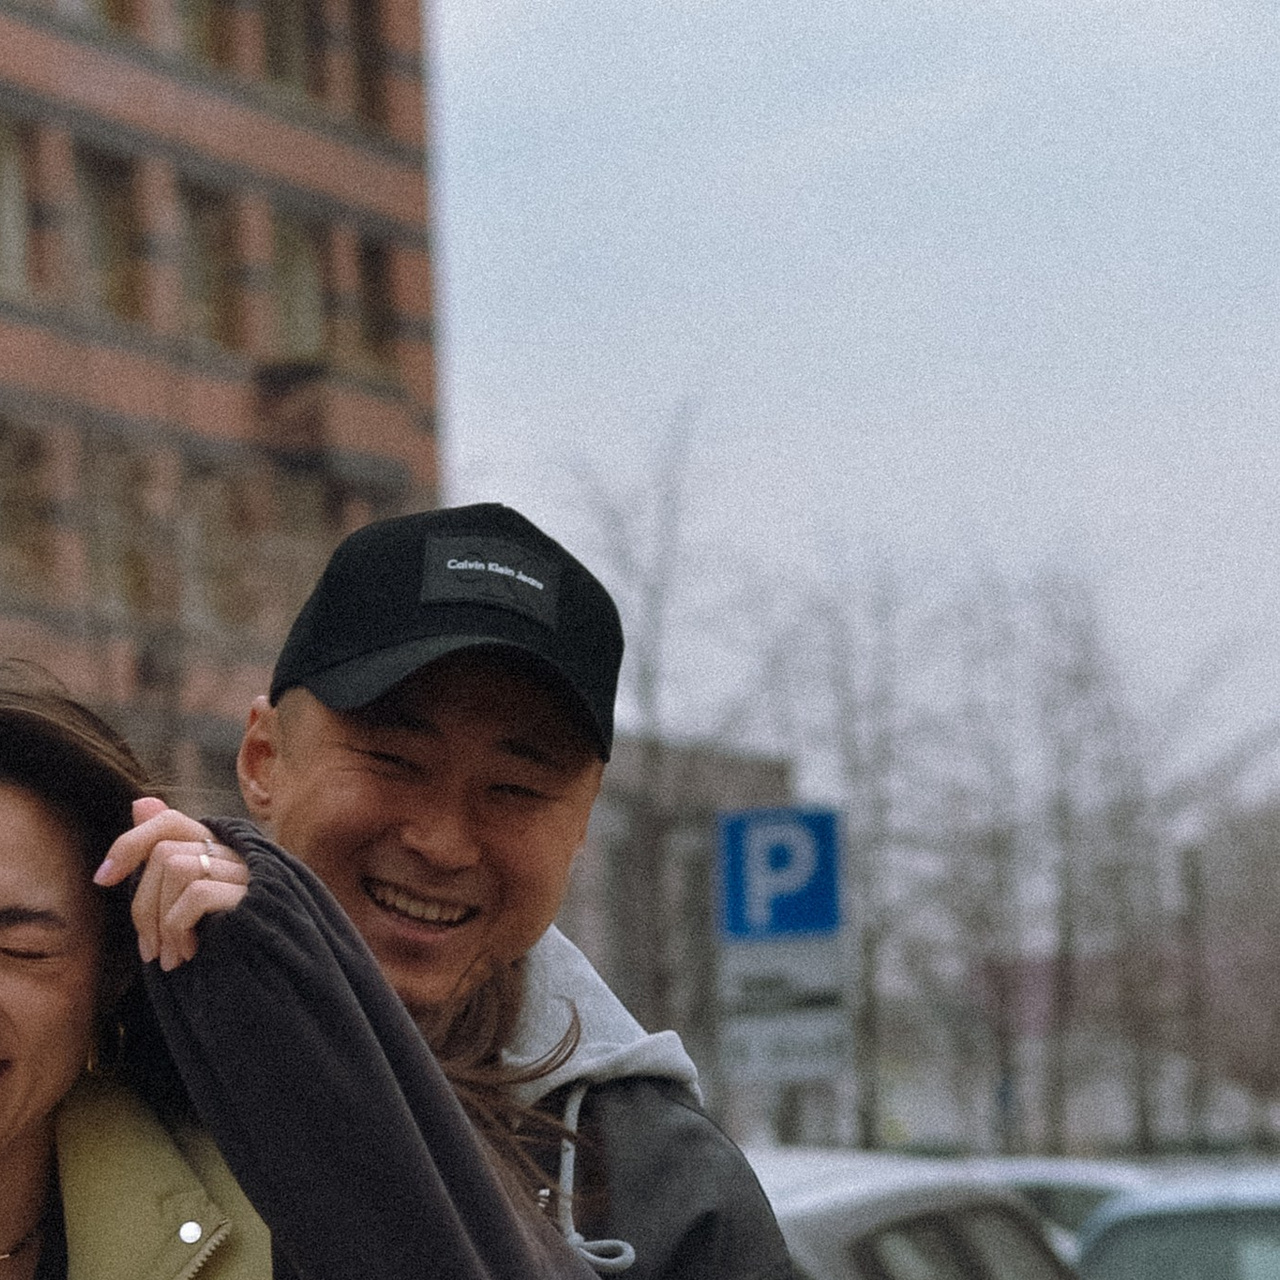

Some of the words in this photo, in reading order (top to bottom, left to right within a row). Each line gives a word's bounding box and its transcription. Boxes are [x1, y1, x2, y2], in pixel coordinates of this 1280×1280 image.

[447, 559, 485, 570] Calvin
[488, 562, 515, 576] Klein
[745, 822, 817, 927] P
